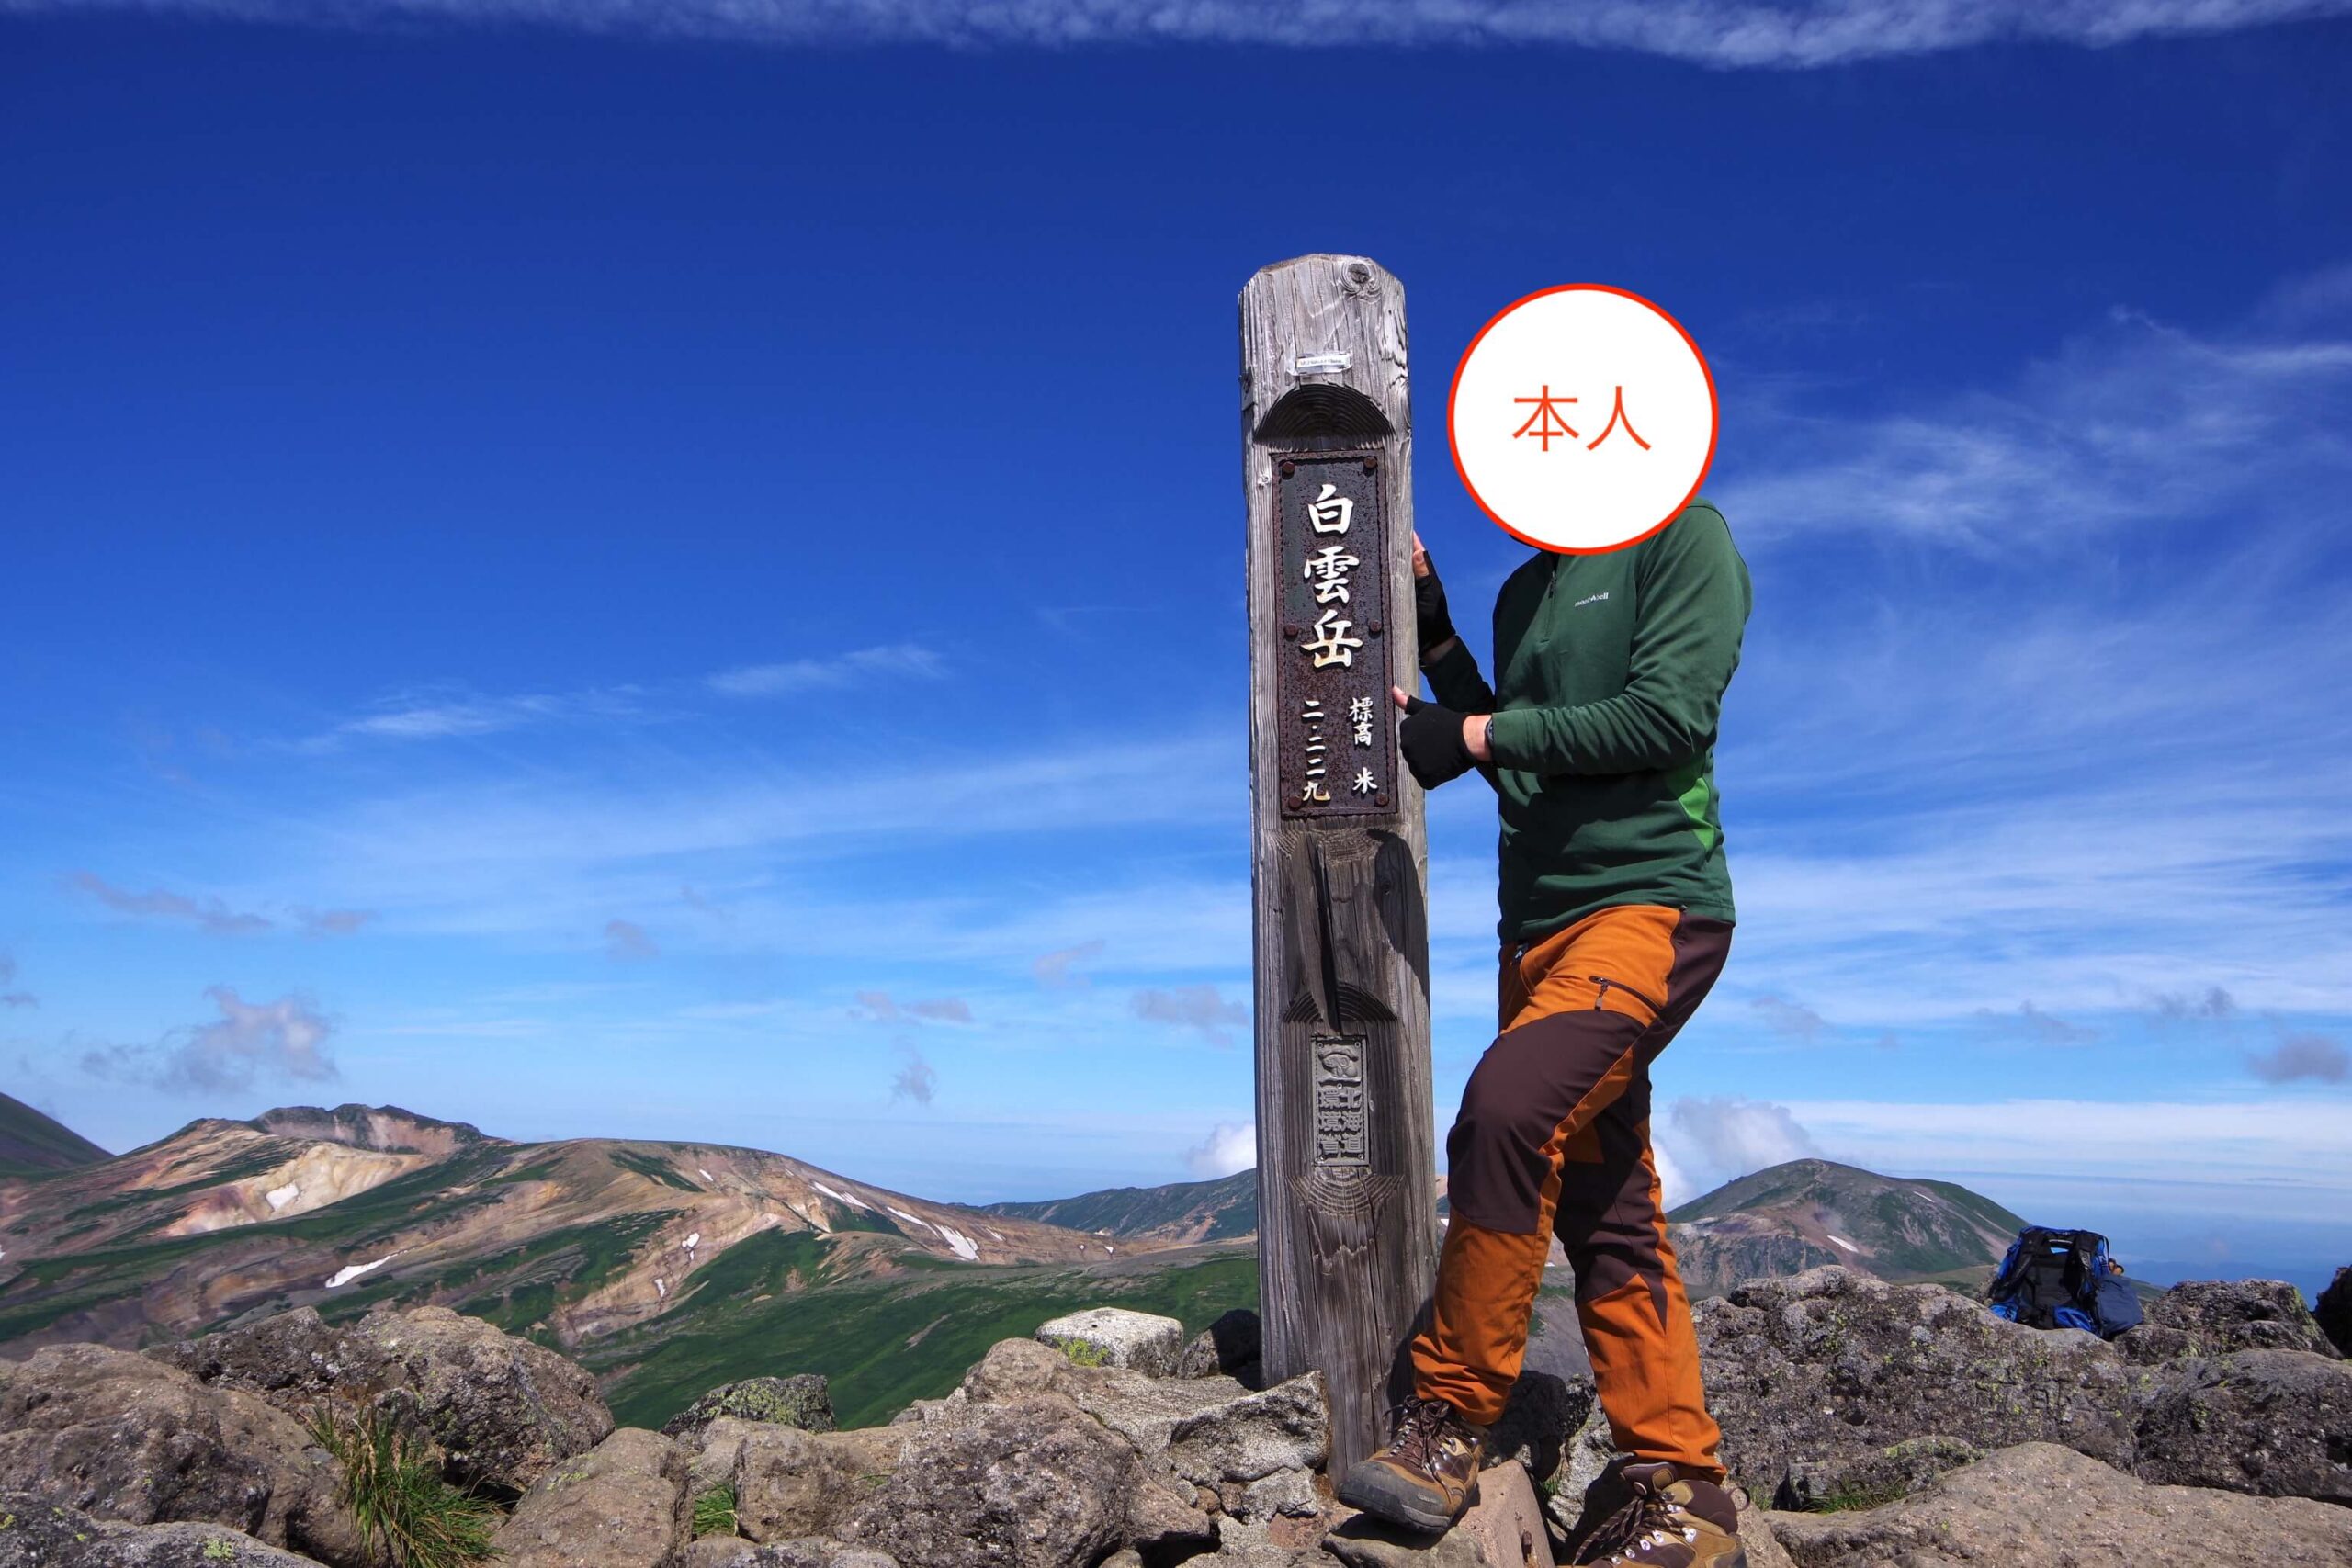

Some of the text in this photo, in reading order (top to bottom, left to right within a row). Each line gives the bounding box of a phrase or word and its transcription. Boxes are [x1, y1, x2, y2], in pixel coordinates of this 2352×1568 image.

[1301, 484, 1363, 669] 白雲岳
[1348, 696, 1378, 794] 標高 米
[1318, 1089, 1340, 1155] 環境省
[1340, 1089, 1362, 1154] 北海道
